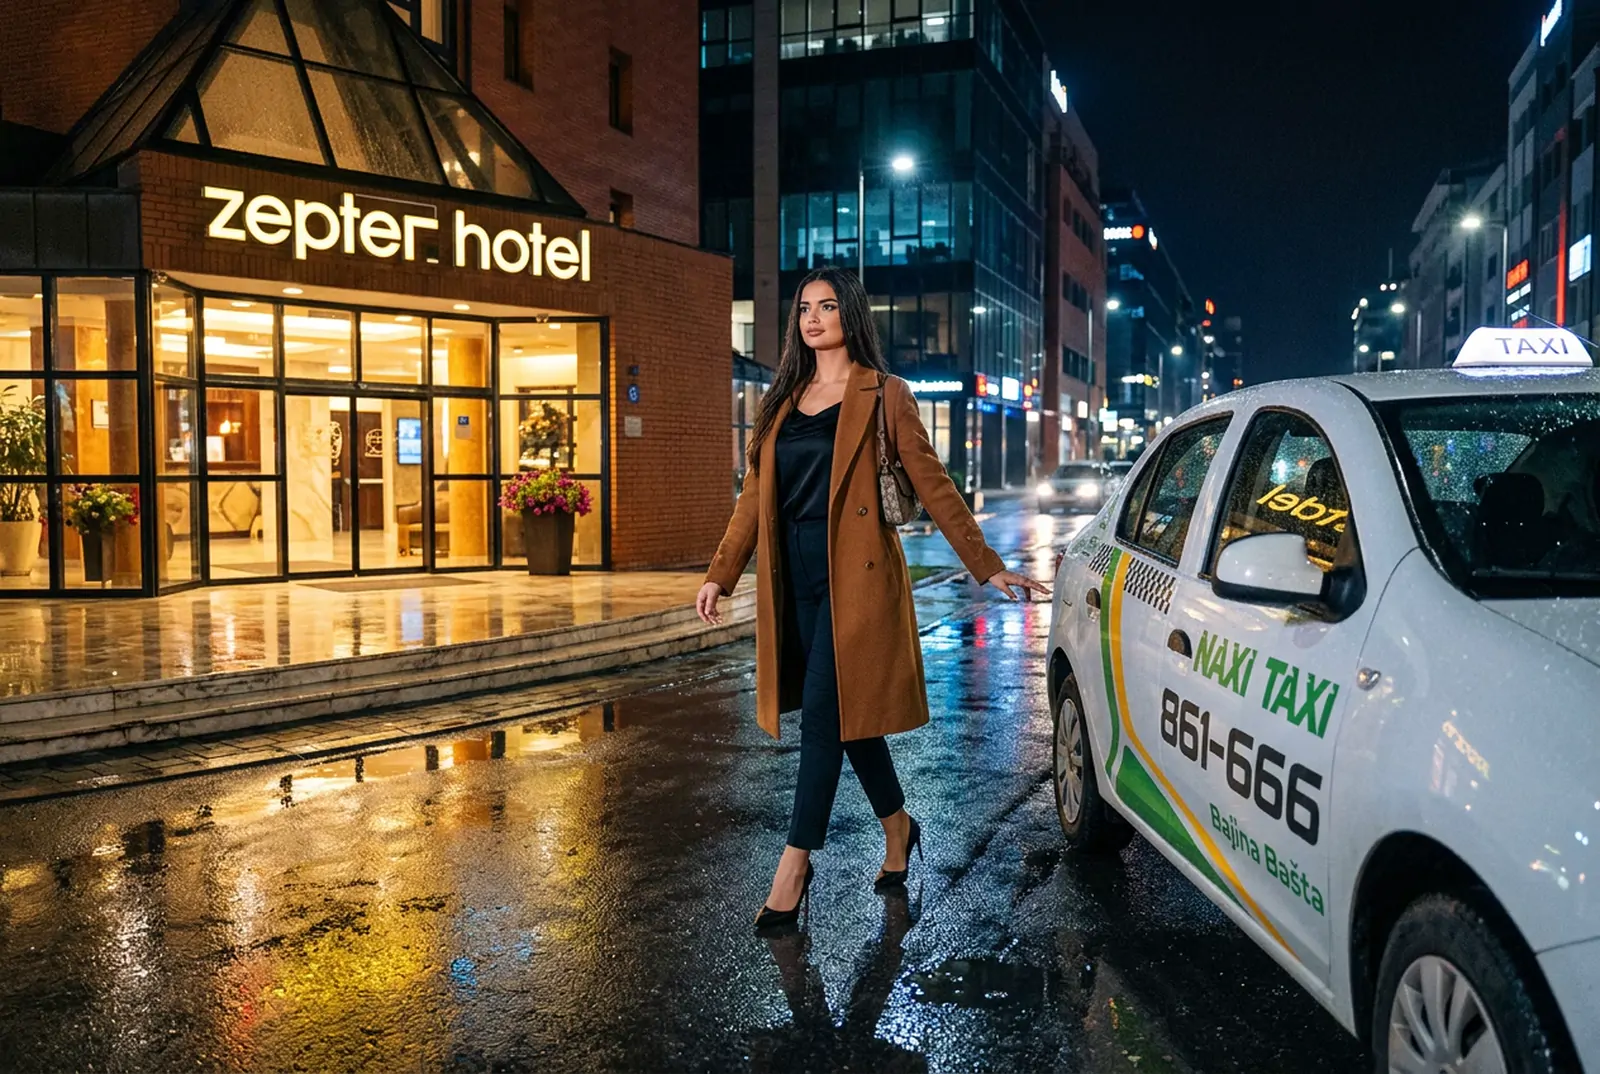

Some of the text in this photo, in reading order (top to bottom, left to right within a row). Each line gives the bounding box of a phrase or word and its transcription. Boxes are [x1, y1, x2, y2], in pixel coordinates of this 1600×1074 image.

[202, 185, 591, 282] zepter hotel
[1494, 337, 1569, 355] TAXI
[1193, 629, 1340, 739] NAXI TAXI
[1160, 687, 1323, 846] 861-666
[1209, 802, 1325, 917] Bajina Bašta
